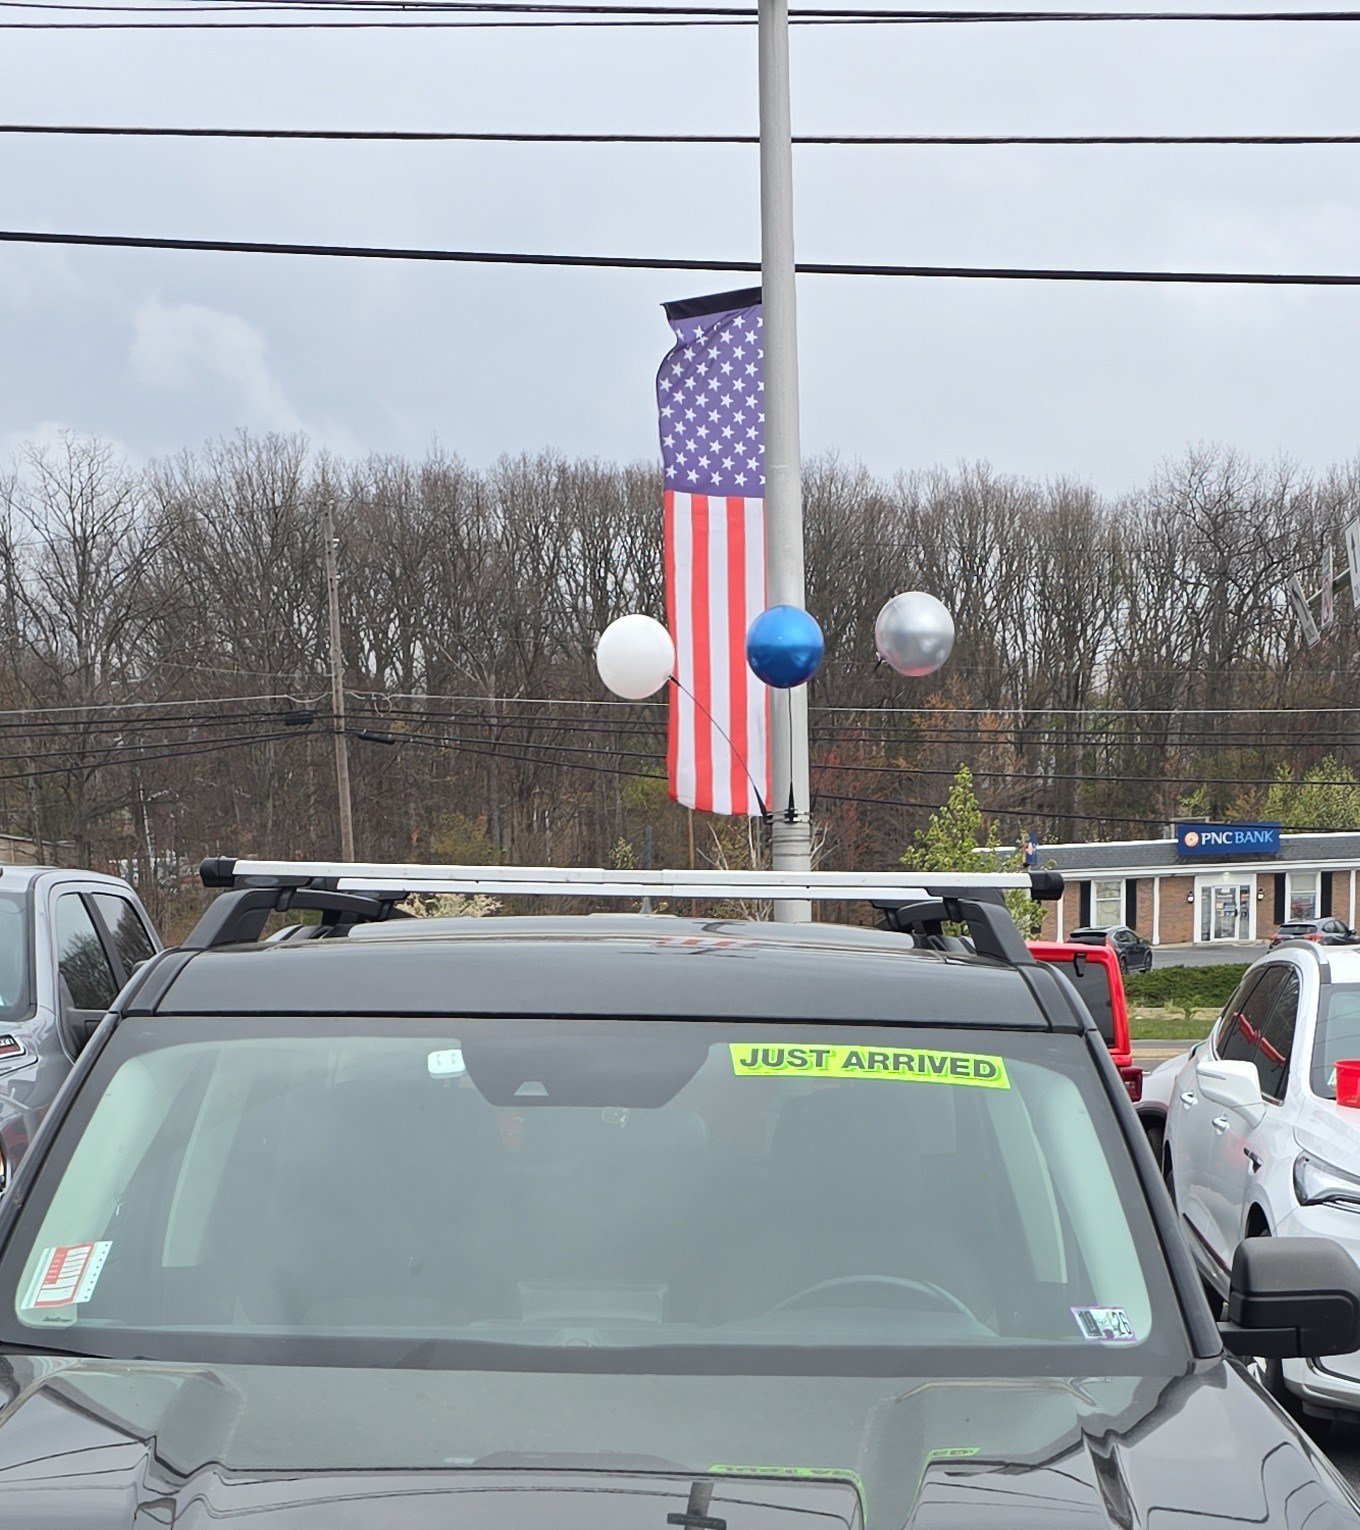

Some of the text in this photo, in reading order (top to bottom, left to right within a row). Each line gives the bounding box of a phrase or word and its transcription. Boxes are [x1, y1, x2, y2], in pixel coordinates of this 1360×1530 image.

[1201, 830, 1274, 845] PNC BANK
[740, 1048, 997, 1078] JUST ARRIVED
